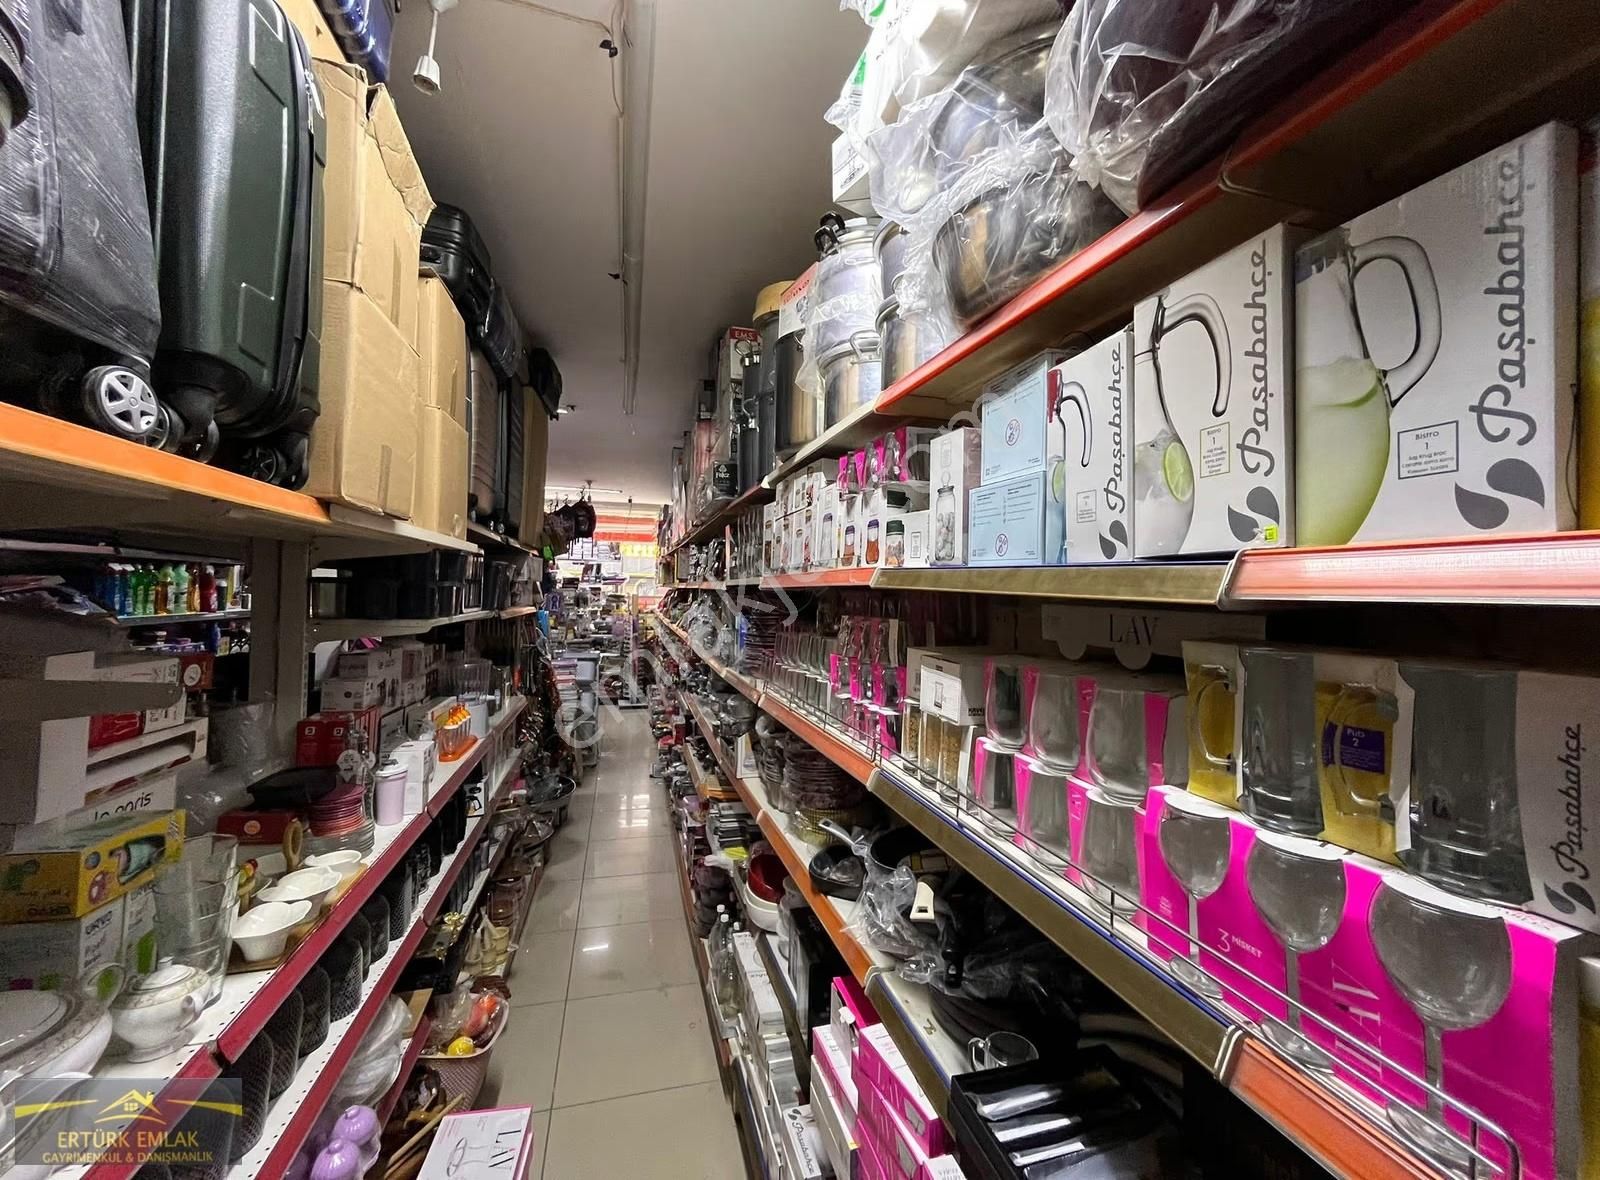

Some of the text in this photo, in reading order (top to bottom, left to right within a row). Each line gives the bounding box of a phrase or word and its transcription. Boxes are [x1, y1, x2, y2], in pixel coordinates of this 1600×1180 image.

[1236, 239, 1275, 477] Paşabahçe
[1103, 342, 1126, 514] Paşabahçe
[1415, 431, 1439, 440] Bistro
[1425, 442, 1429, 450] 1
[1108, 614, 1160, 646] LAV
[1346, 728, 1365, 738] Pub
[1352, 737, 1360, 746] 2
[1550, 724, 1590, 880] Paşabahçe
[1217, 927, 1230, 952] 3
